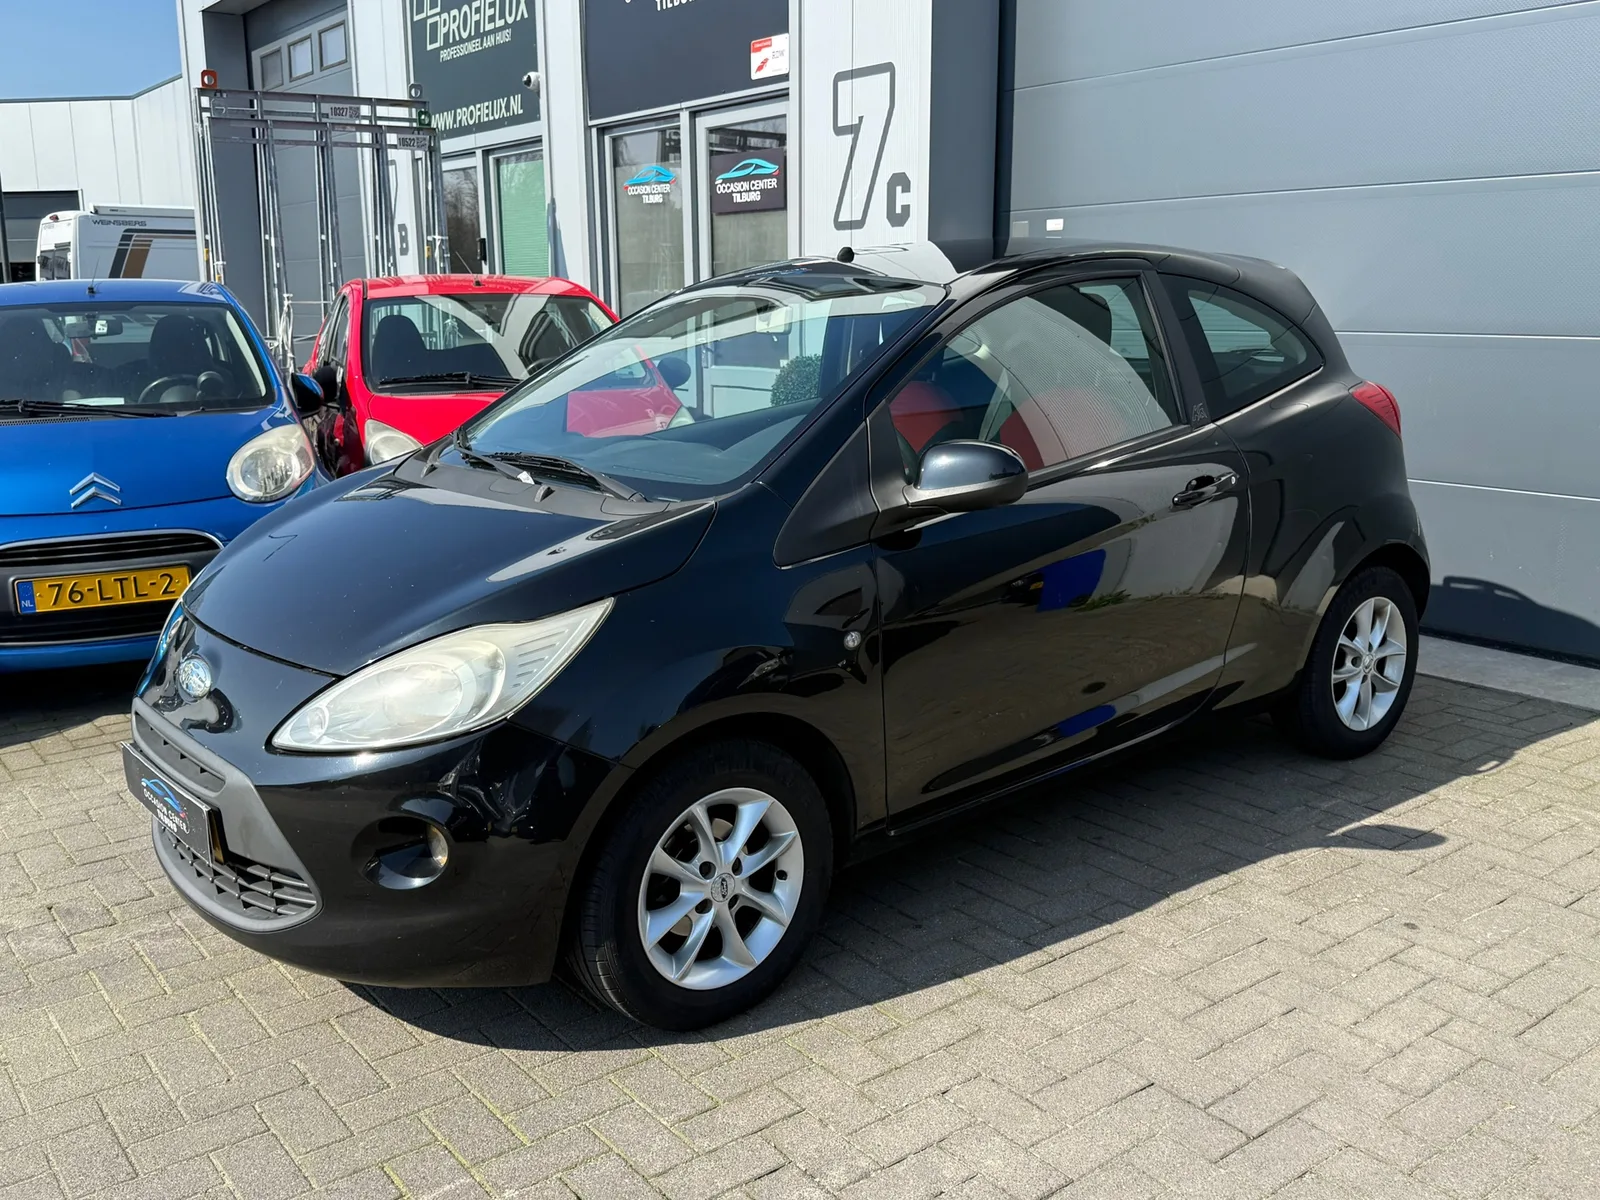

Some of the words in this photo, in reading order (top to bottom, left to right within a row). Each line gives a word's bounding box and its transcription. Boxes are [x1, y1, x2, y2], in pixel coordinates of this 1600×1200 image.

[440, 0, 528, 46] PROFIELUX
[440, 38, 482, 62] PROFESSIONEEL
[482, 33, 495, 49] AAN
[496, 27, 512, 45] HUIS!
[330, 106, 349, 119] 10327
[398, 136, 416, 148] 10522
[627, 184, 651, 195] OCCASION
[650, 183, 671, 194] CENTER
[716, 181, 750, 194] OCCASION
[750, 178, 778, 191] CENTER
[642, 194, 663, 204] TILBURG
[732, 191, 761, 203] TILBURG
[48, 573, 176, 607] 76-LTL-2
[21, 600, 34, 608] NL
